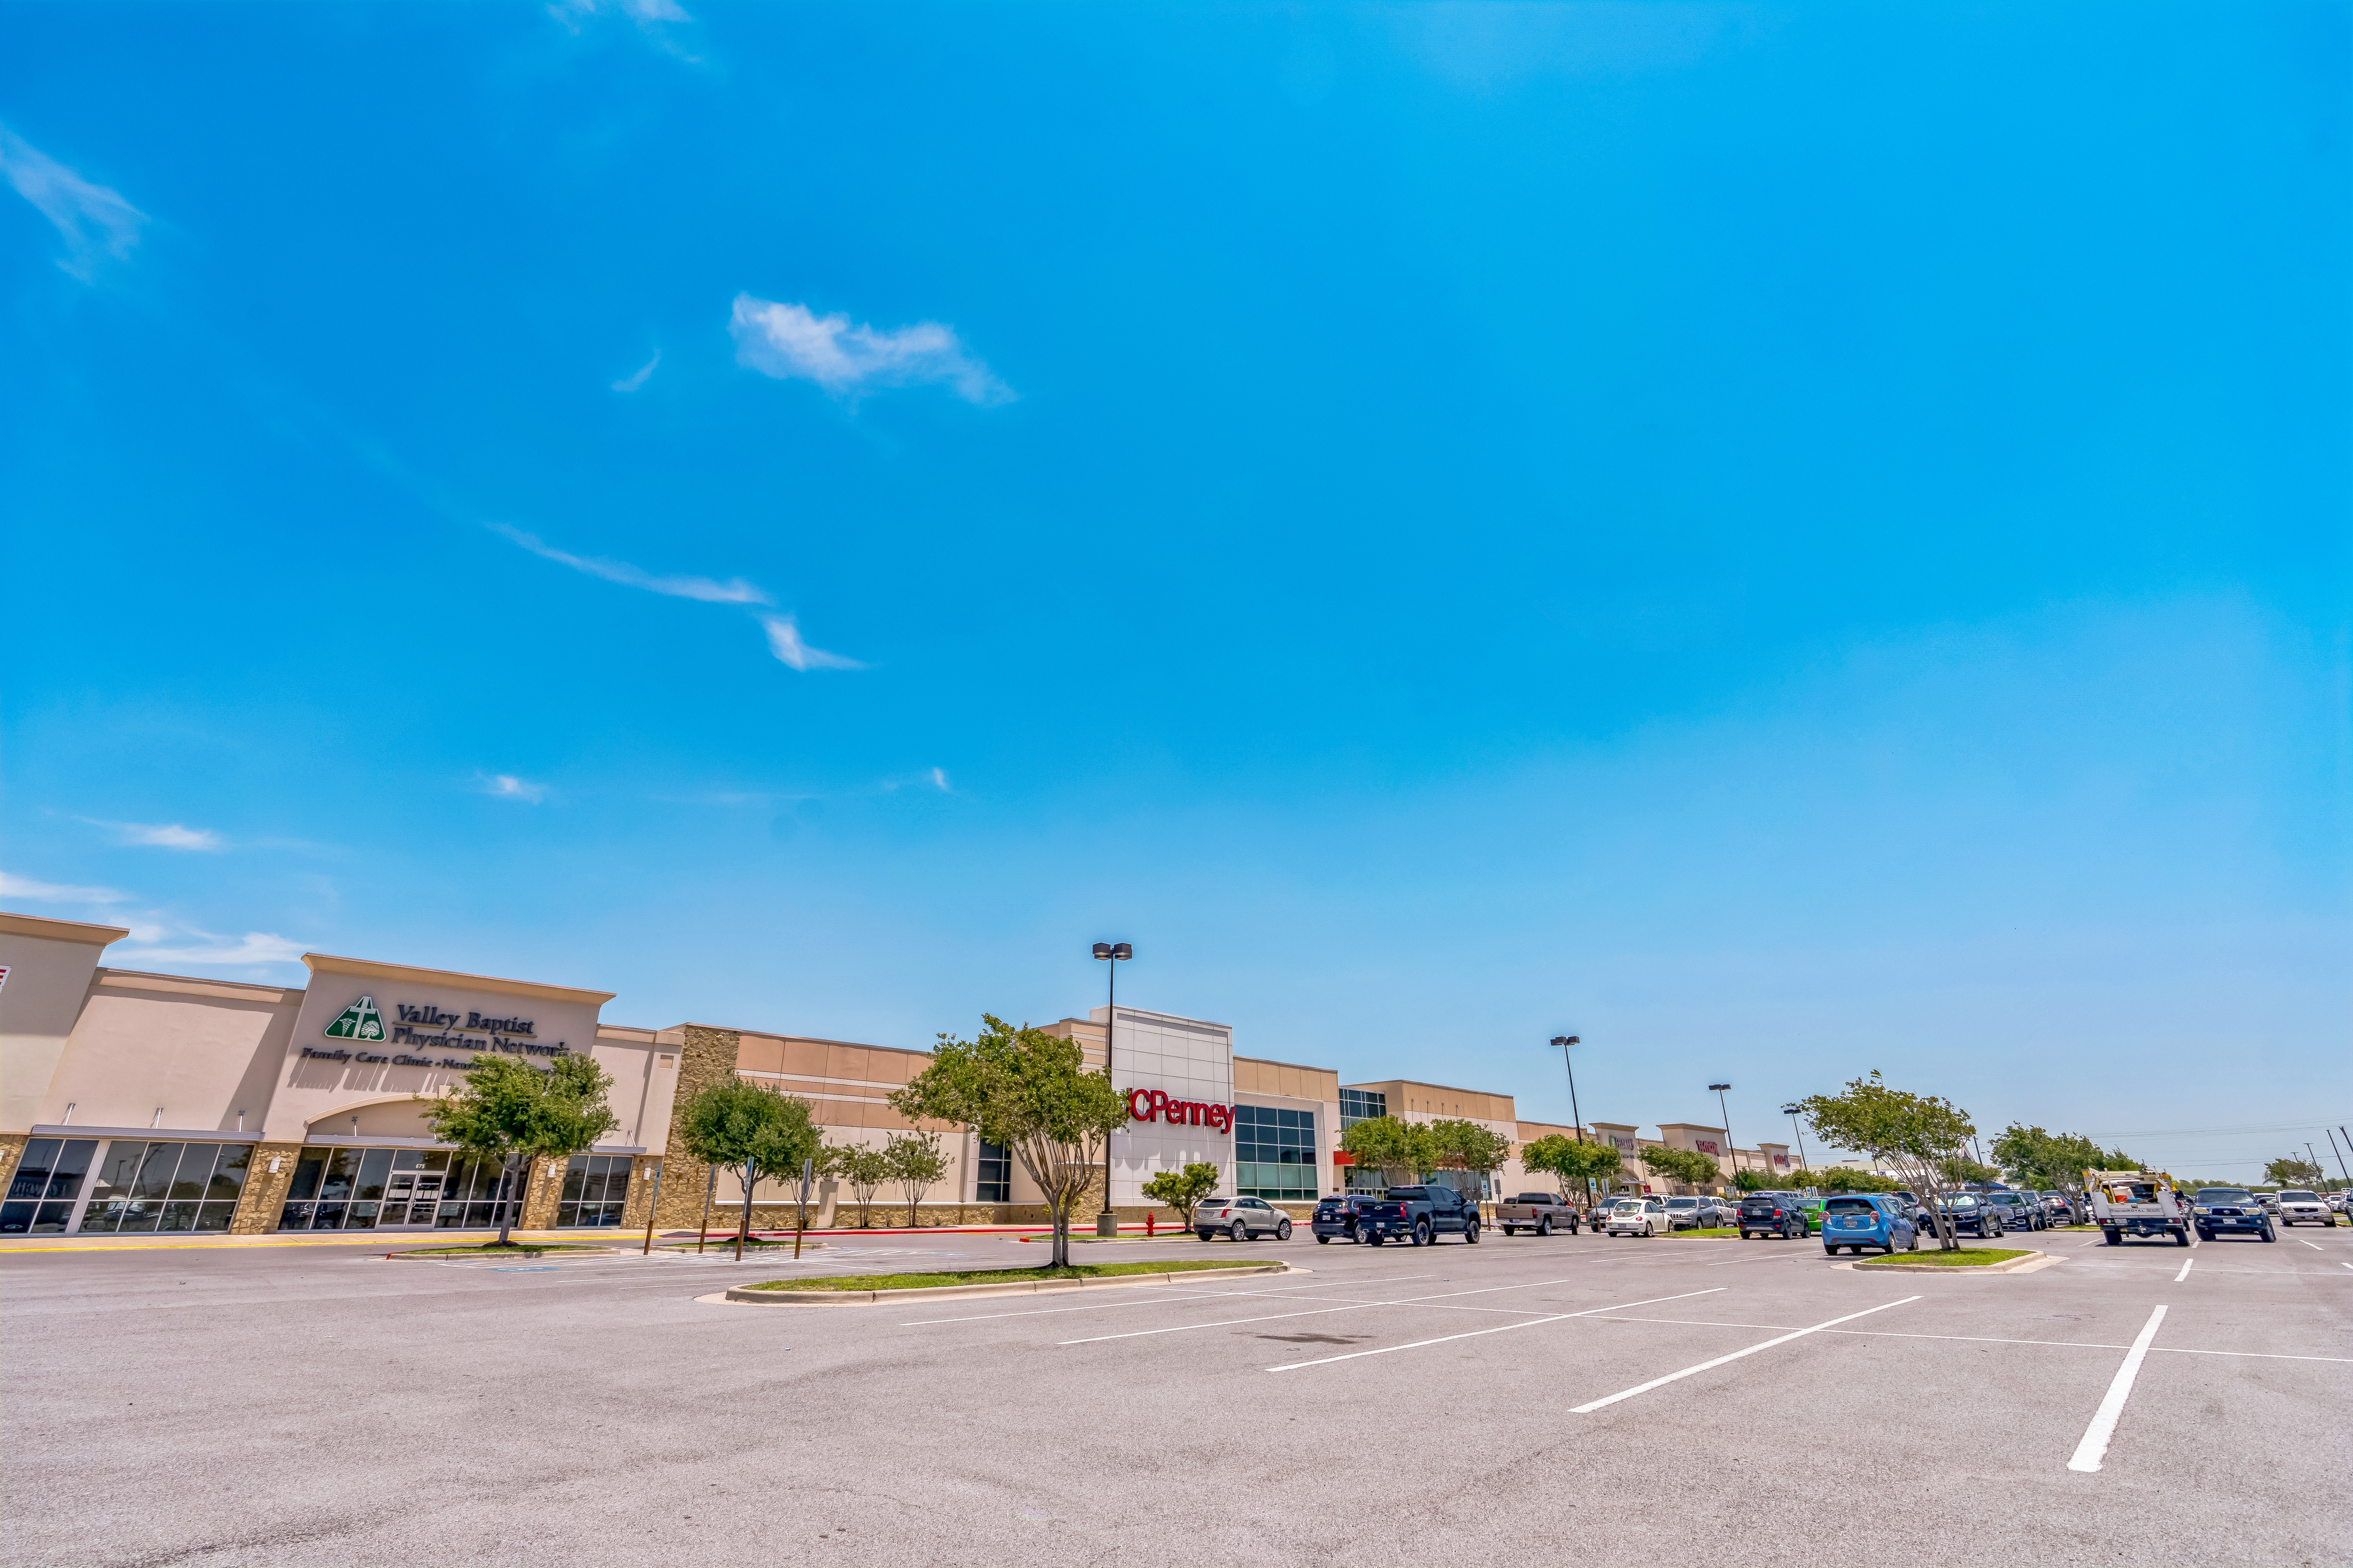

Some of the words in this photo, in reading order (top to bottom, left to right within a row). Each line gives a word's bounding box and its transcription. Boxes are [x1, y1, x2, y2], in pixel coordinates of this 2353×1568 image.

[396, 1004, 461, 1030] Valley
[465, 1012, 535, 1035] Baptist
[301, 1047, 353, 1065] Family
[355, 1052, 389, 1064] Care
[392, 1055, 434, 1067] Clinic
[391, 1027, 487, 1052] Physician
[491, 1036, 570, 1057] Network
